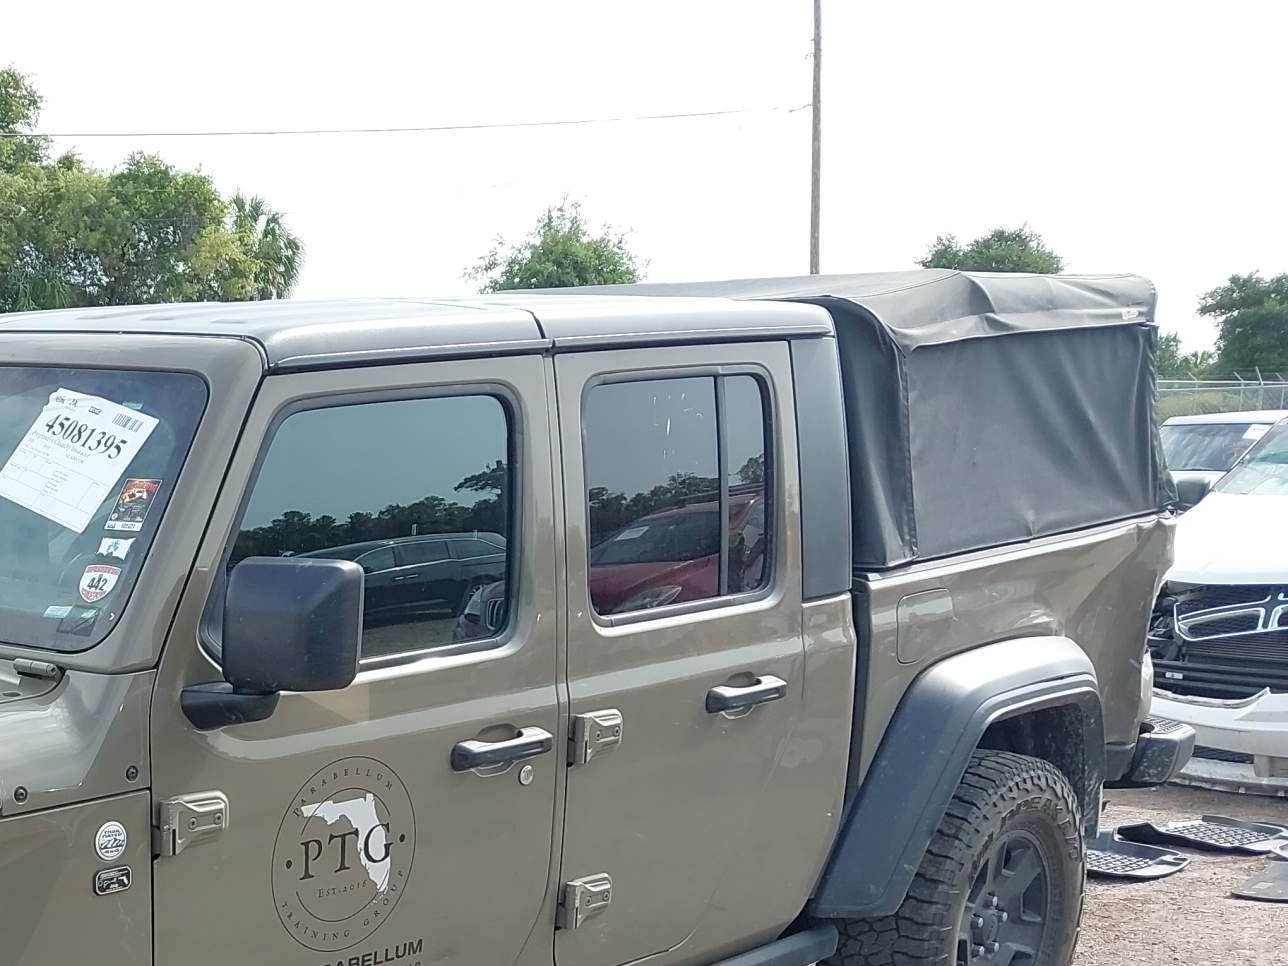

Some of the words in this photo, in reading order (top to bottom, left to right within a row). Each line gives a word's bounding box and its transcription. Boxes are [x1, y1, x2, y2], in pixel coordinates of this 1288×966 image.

[44, 413, 129, 460] 45081395
[292, 767, 394, 817] PARABELLUM
[299, 822, 394, 880] PTG
[281, 901, 351, 941] TRAINING
[362, 870, 404, 927] GROUP
